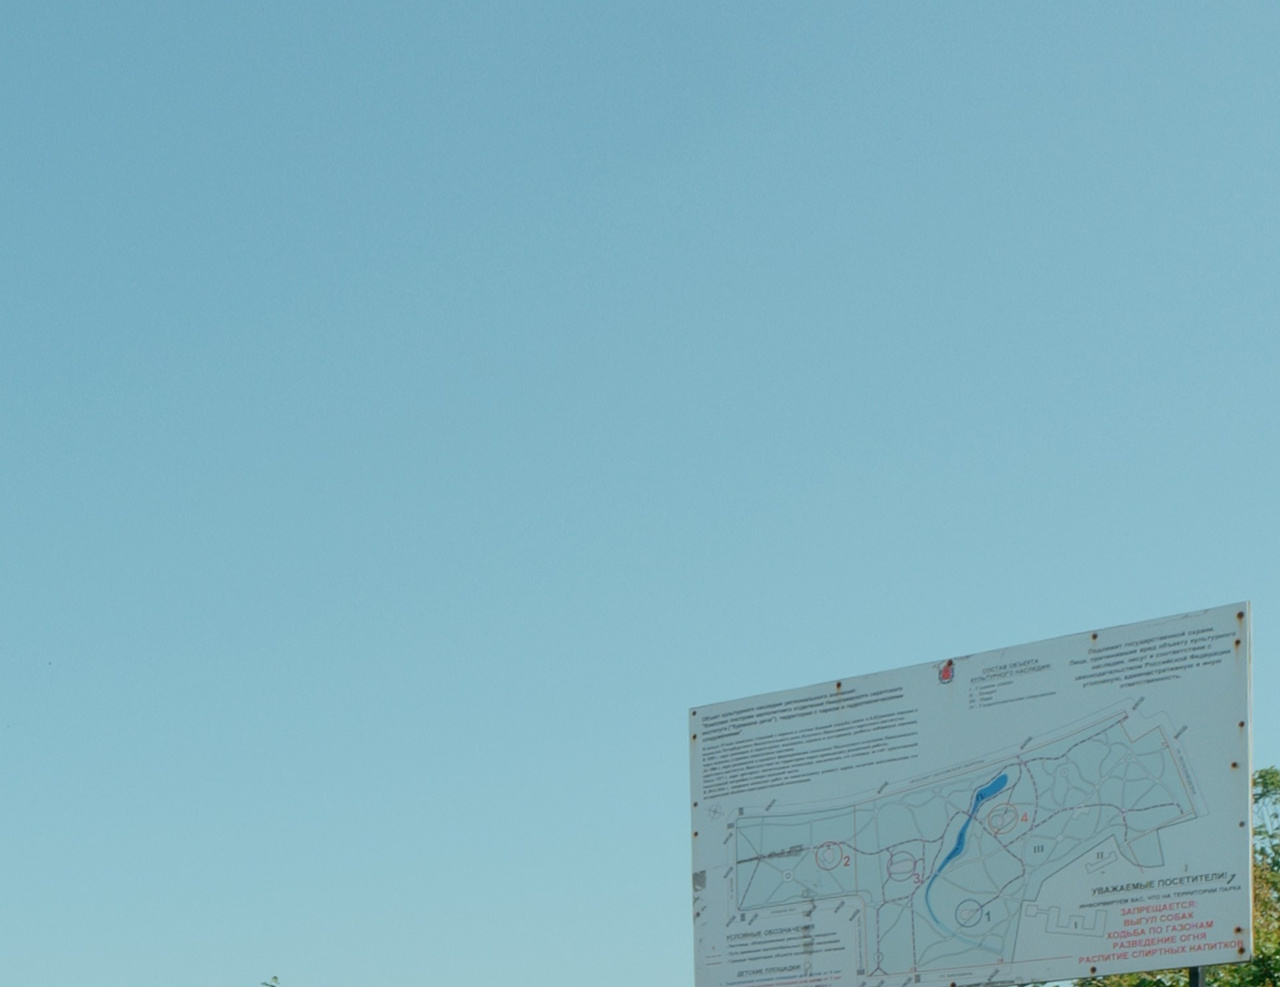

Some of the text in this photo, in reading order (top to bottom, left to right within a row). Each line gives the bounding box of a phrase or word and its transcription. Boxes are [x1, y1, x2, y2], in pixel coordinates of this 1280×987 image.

[1020, 812, 1028, 822] 4
[843, 856, 850, 867] 2
[913, 874, 920, 884] 3
[1091, 872, 1228, 896] УВАЖАЕМЫЕ ПОСЕТИТЕЛИ!
[1173, 888, 1218, 898] ТЕРРИТОРИИ
[1120, 900, 1198, 916] ЗАПРЕЩАЕТСЯ:
[984, 912, 991, 922] 1
[1123, 912, 1194, 926] ВЫГУЛ СОБАК
[1106, 920, 1214, 940] ХОДЬБА ПО ГАЗОНАМ
[1112, 932, 1207, 950] РАЗВЕДЕНИЕ ОГНЯ
[1078, 939, 1244, 964] РАСПИТИЕ СПИРТНЫХ НАПИТКОВ
